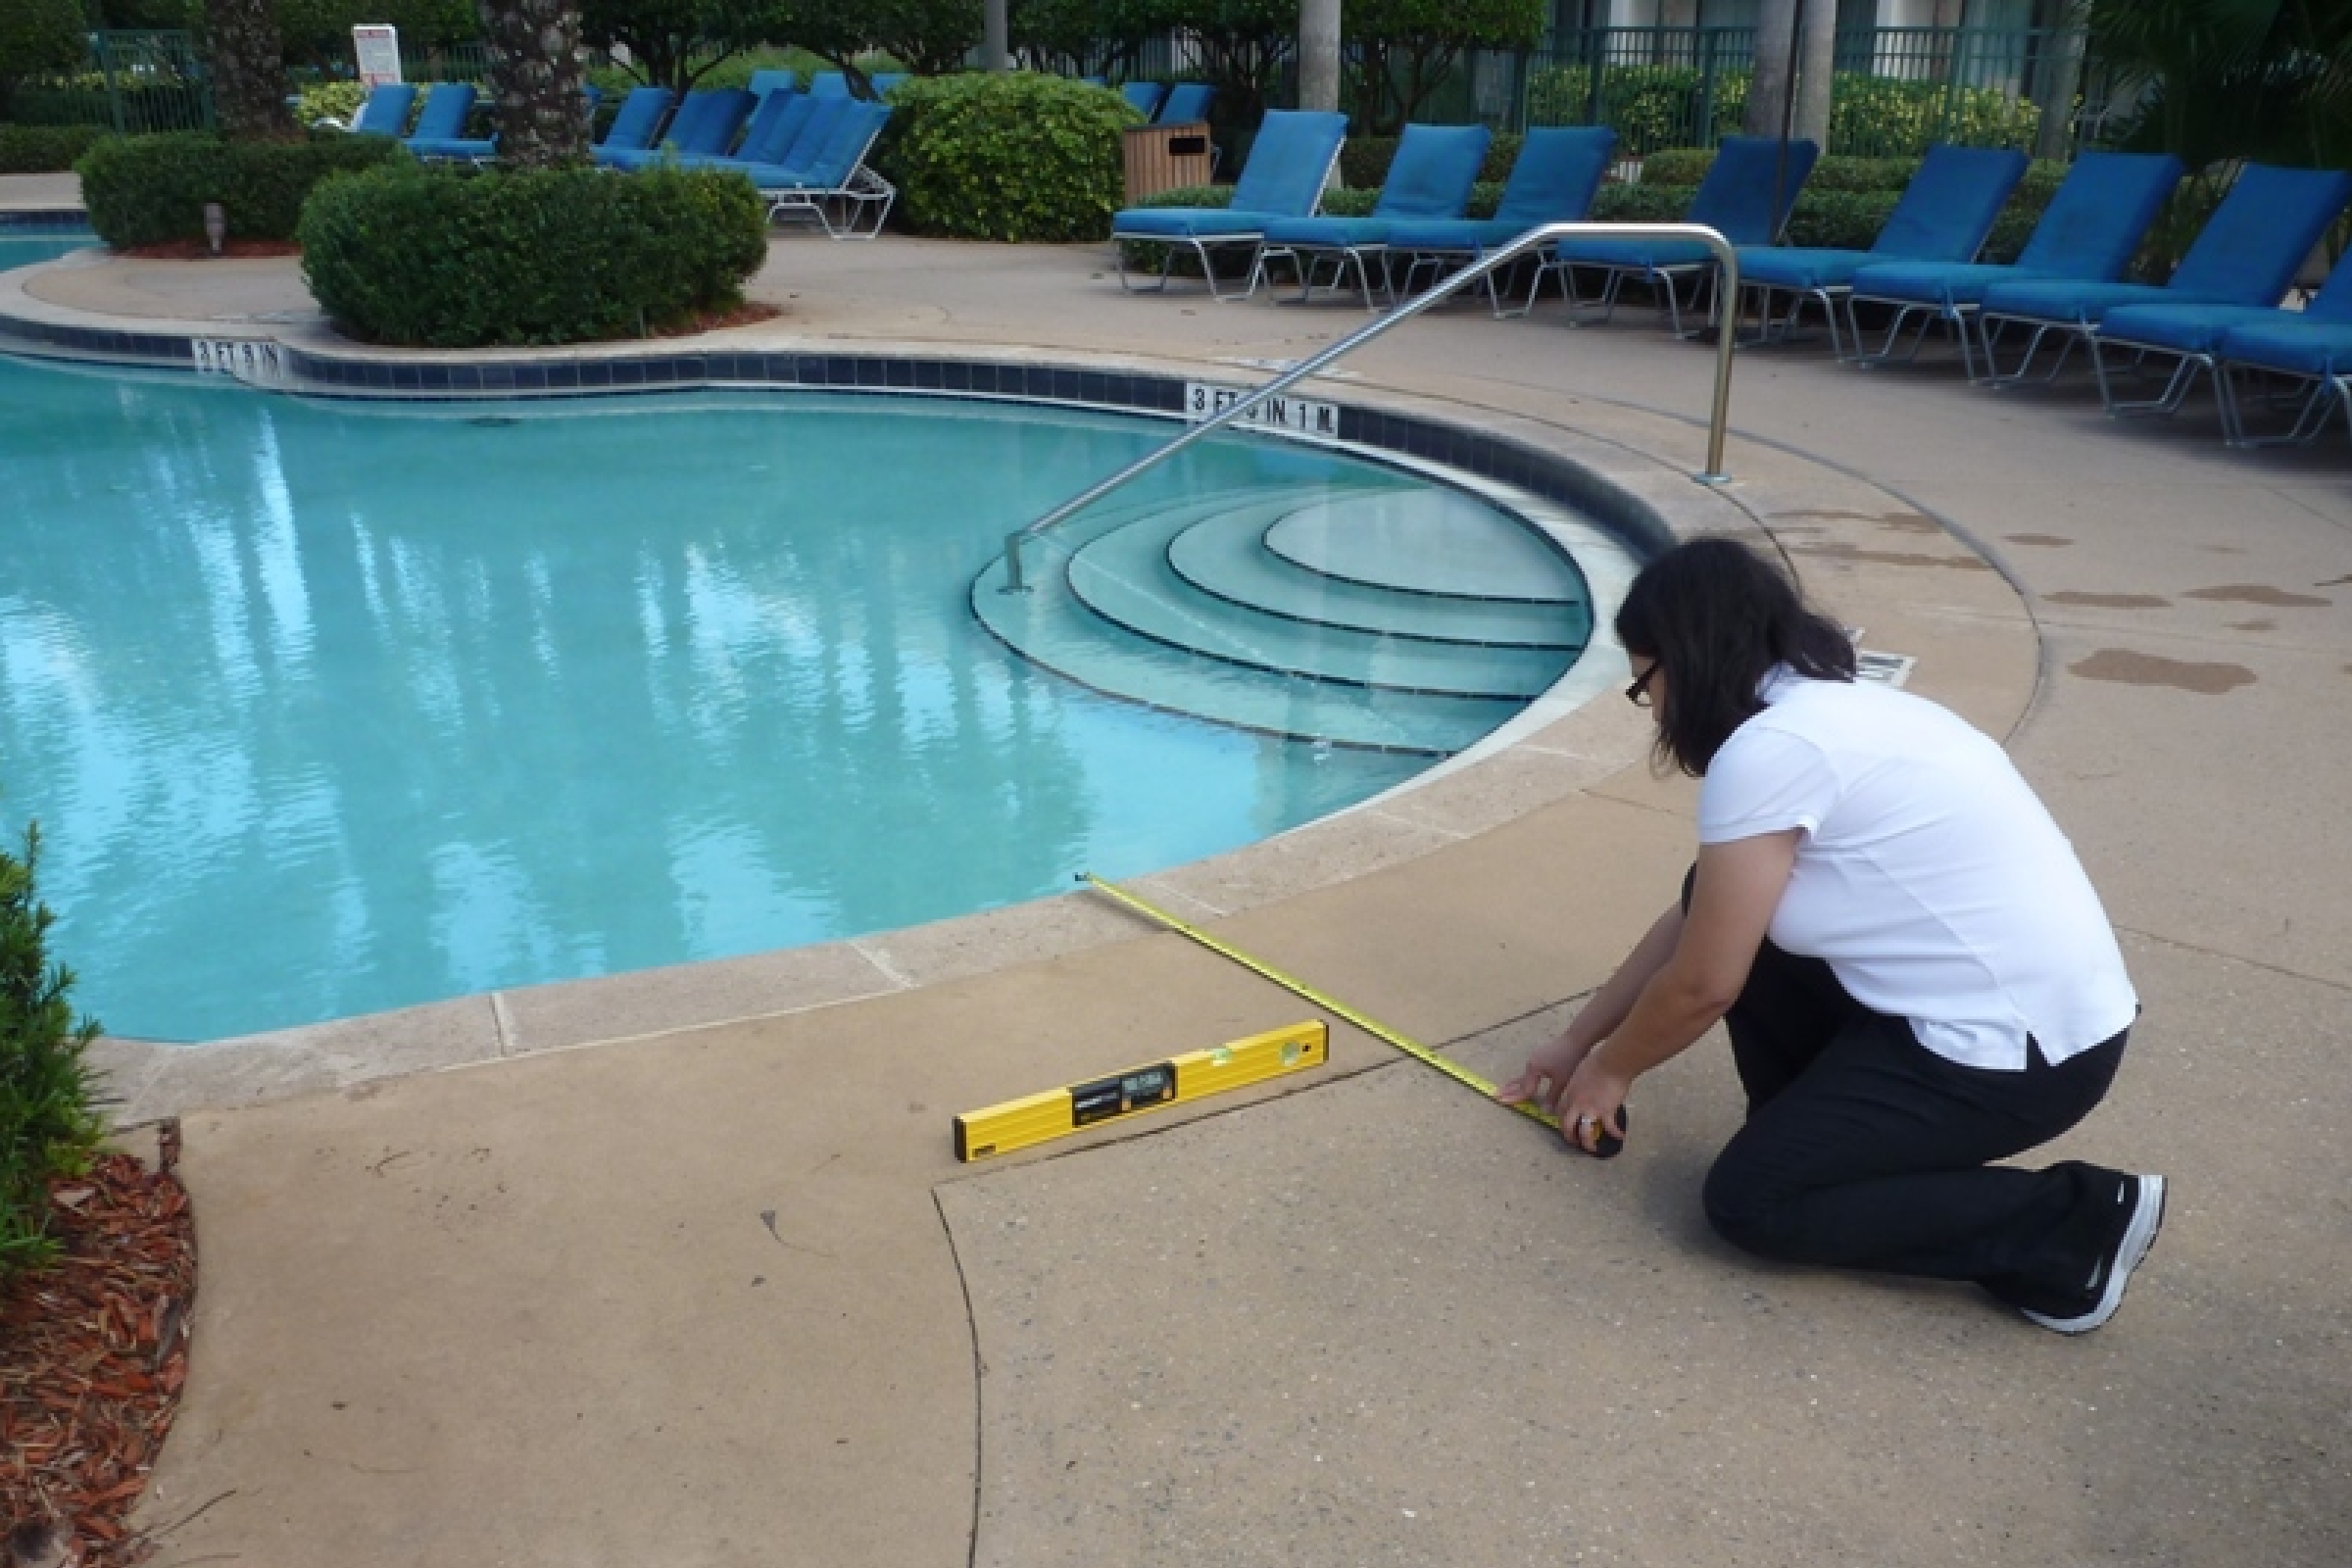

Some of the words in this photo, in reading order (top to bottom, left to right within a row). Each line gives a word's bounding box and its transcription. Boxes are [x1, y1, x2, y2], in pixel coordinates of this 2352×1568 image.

[216, 341, 234, 368] FT
[259, 344, 281, 376] IN
[1194, 388, 1206, 411] 3
[1298, 404, 1306, 430] 1
